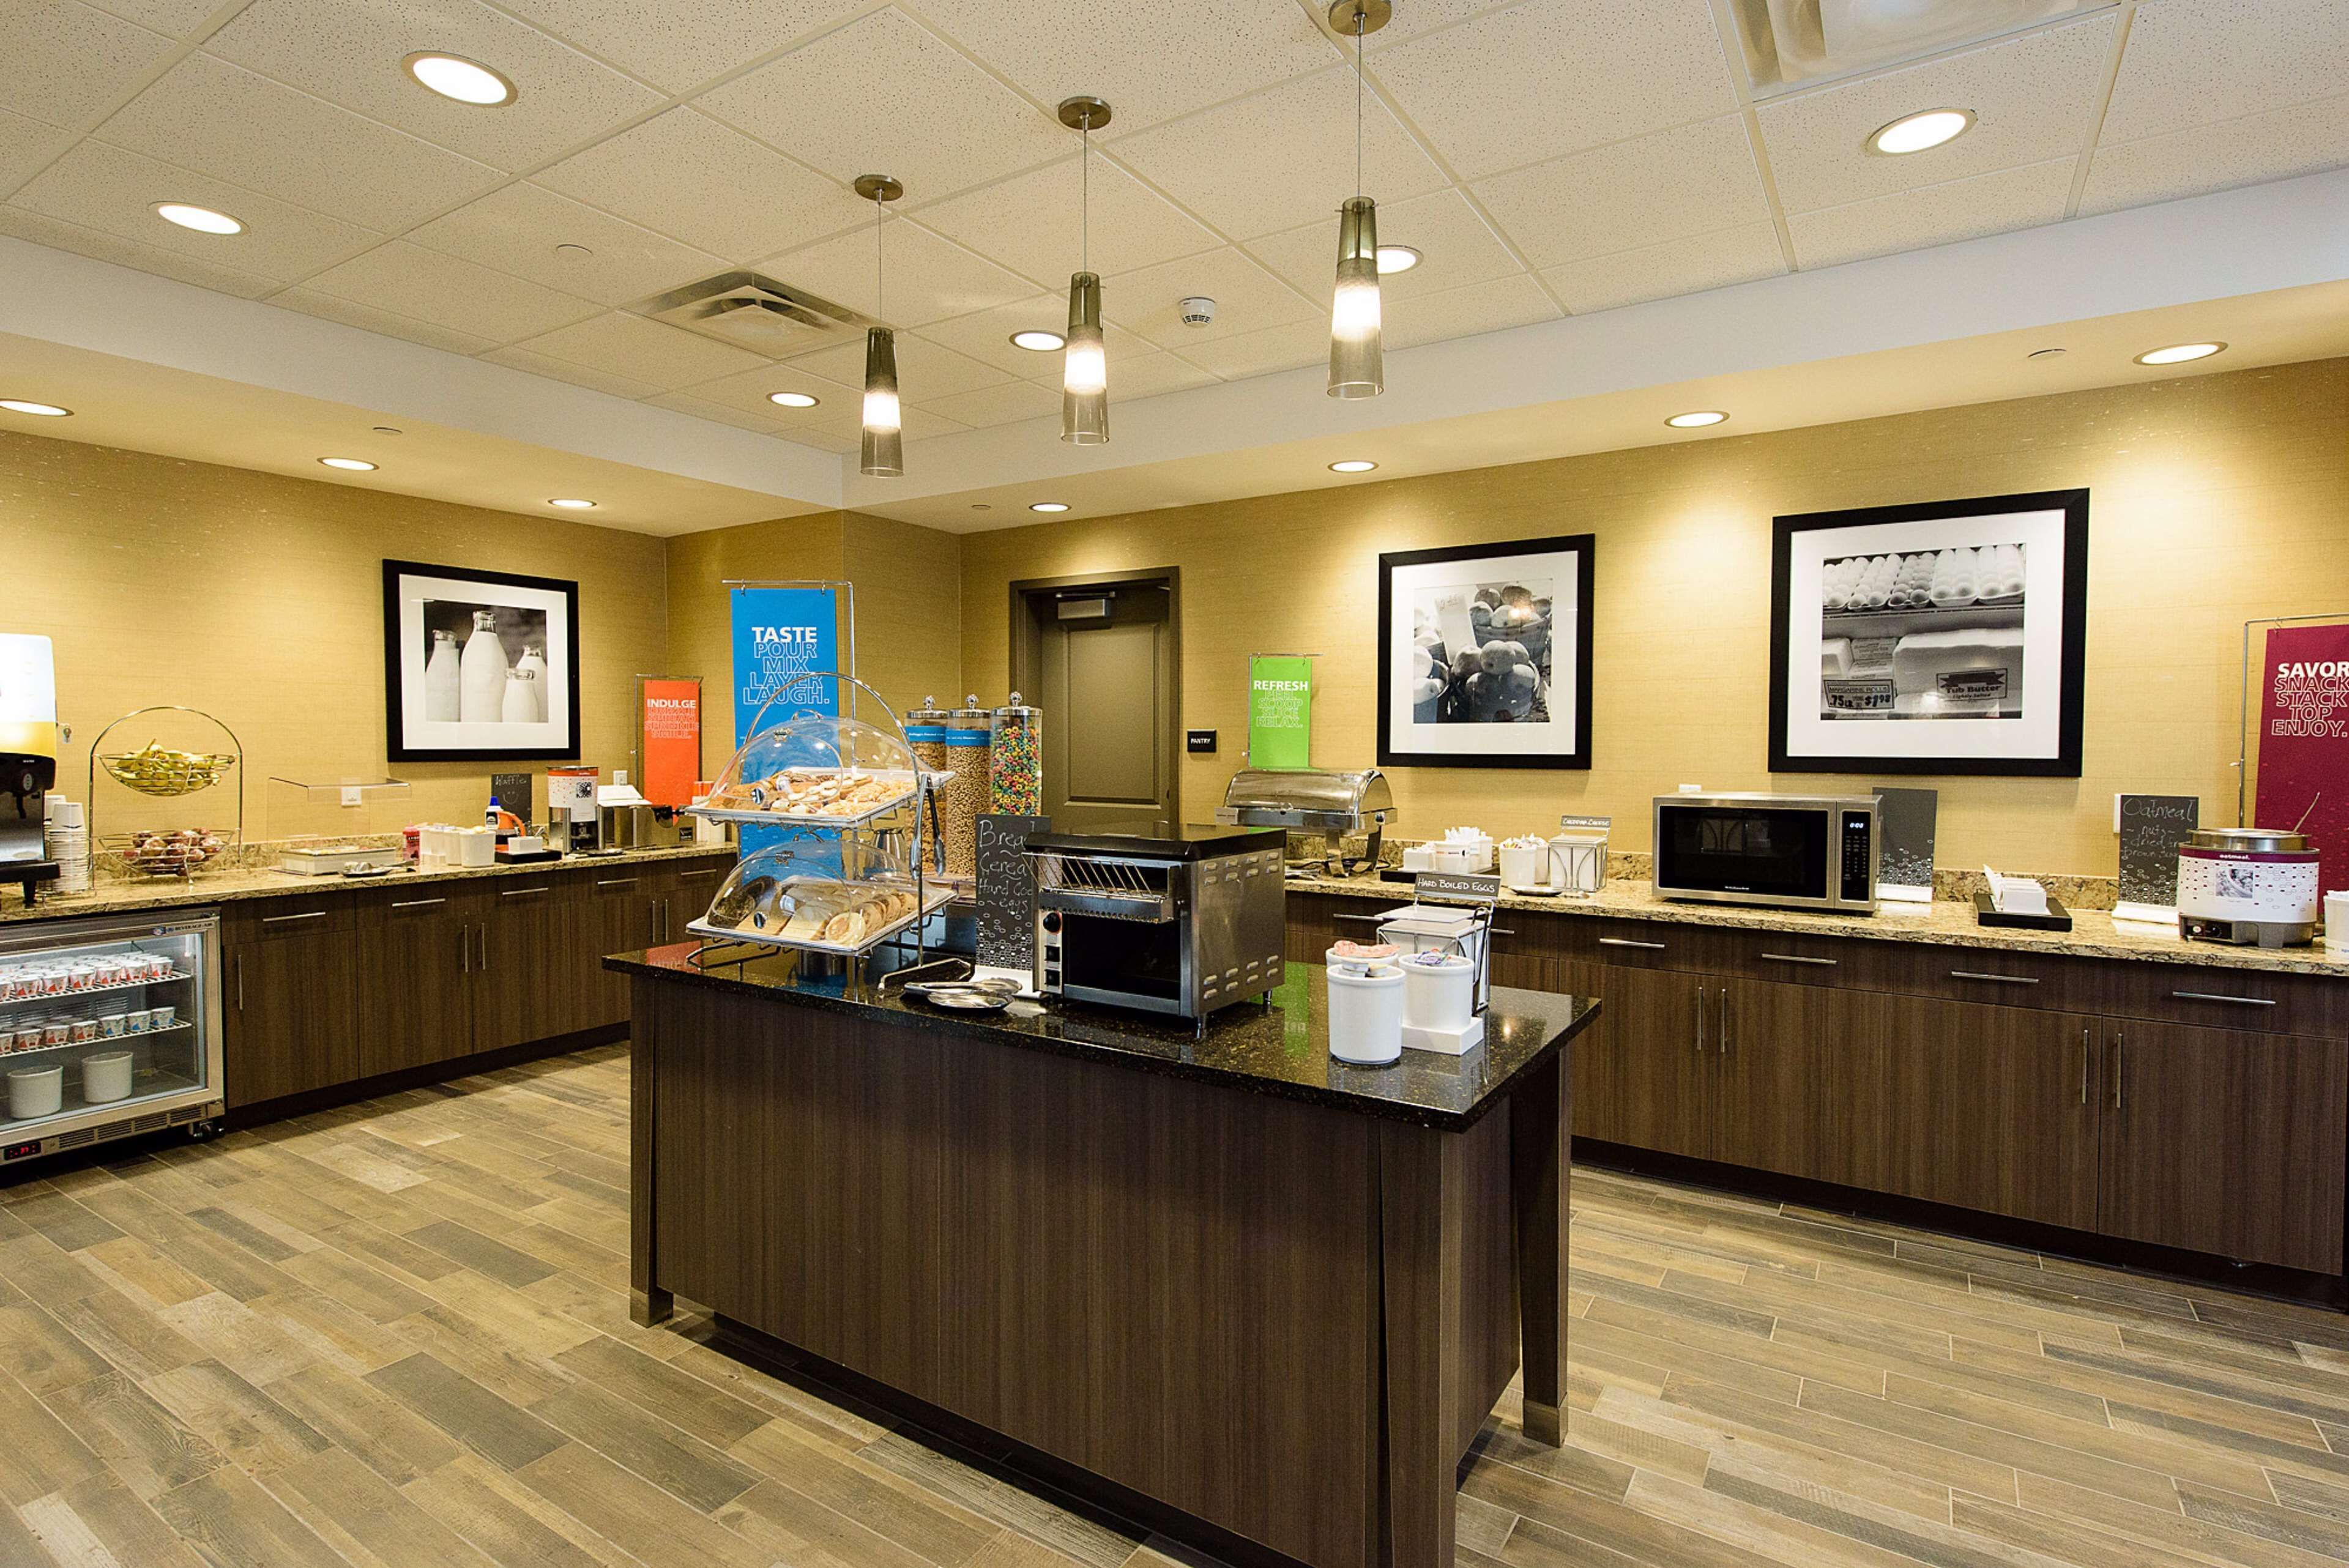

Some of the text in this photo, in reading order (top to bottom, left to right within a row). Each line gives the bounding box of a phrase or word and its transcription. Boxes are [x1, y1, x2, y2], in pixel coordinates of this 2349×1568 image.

[751, 627, 817, 642] TASTE
[754, 641, 817, 658] POUR
[763, 656, 810, 673] MIX
[2278, 662, 2349, 678] SAVOR
[750, 672, 822, 688] LAYER
[1253, 680, 1308, 691] REFRESH
[2274, 677, 2349, 692] SNACK
[647, 699, 696, 708] INDULGE
[743, 687, 830, 704] LAUGH.
[2276, 691, 2348, 707] STACK
[2289, 706, 2332, 721] TOP
[2271, 719, 2348, 737] ENJOY.
[2123, 798, 2196, 822] Oatmeal
[979, 878, 1033, 897] Hard Coo
[1418, 877, 1495, 893] HARD BOILED EGGS
